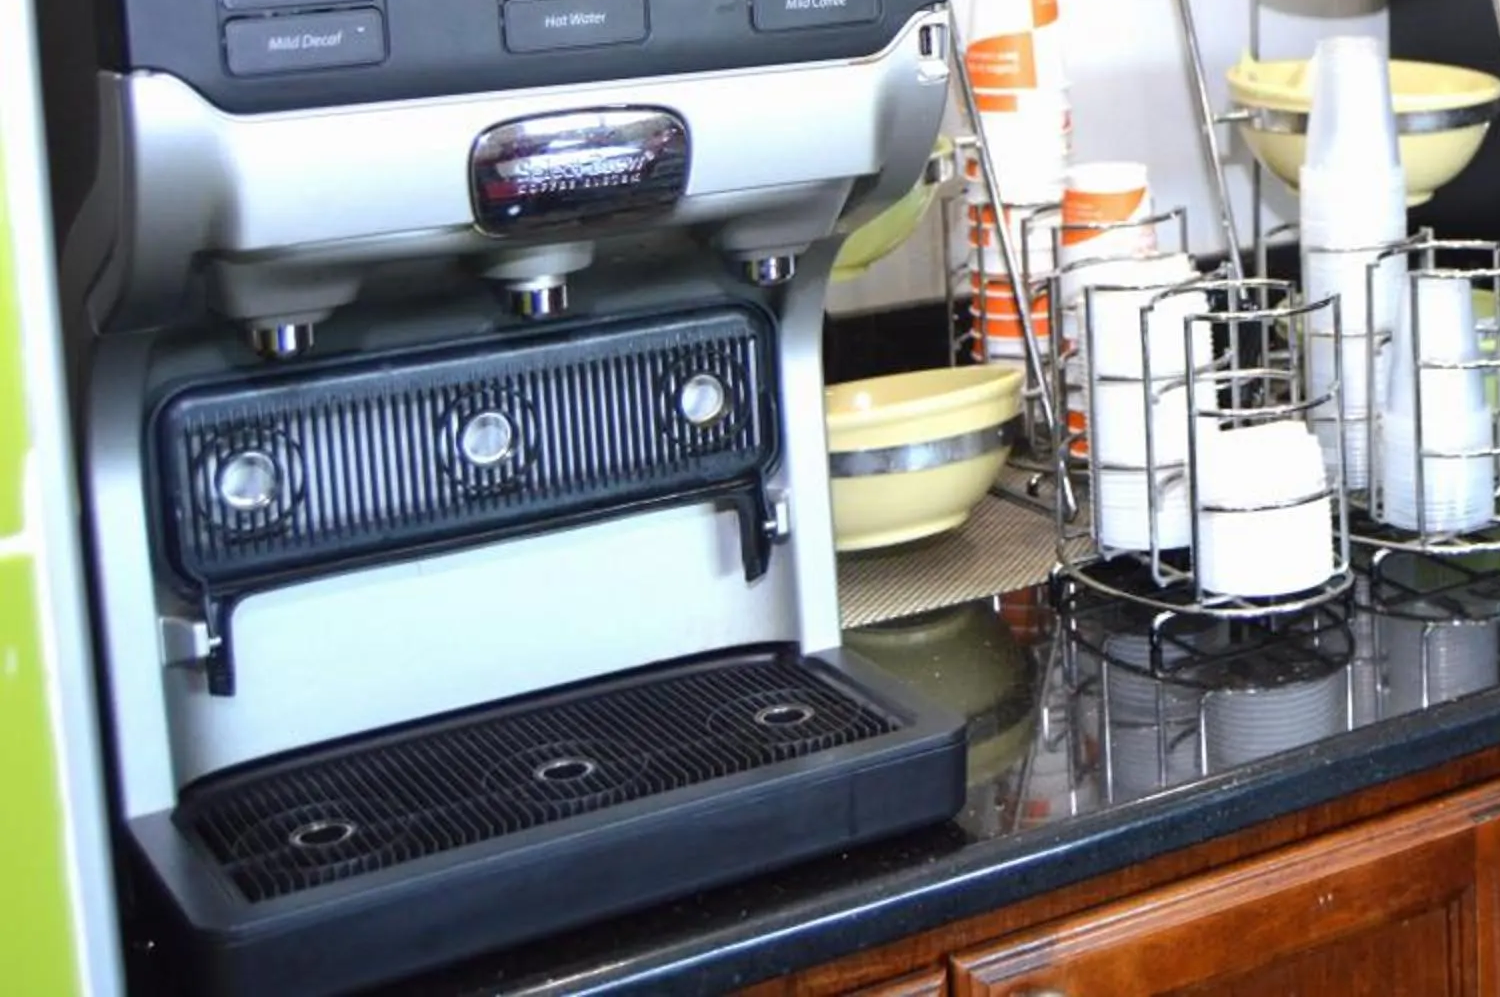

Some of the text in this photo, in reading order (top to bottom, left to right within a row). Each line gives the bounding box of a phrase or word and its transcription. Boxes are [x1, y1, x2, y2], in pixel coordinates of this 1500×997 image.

[544, 11, 607, 29] Hot Water
[267, 31, 343, 52] Mild Decaf
